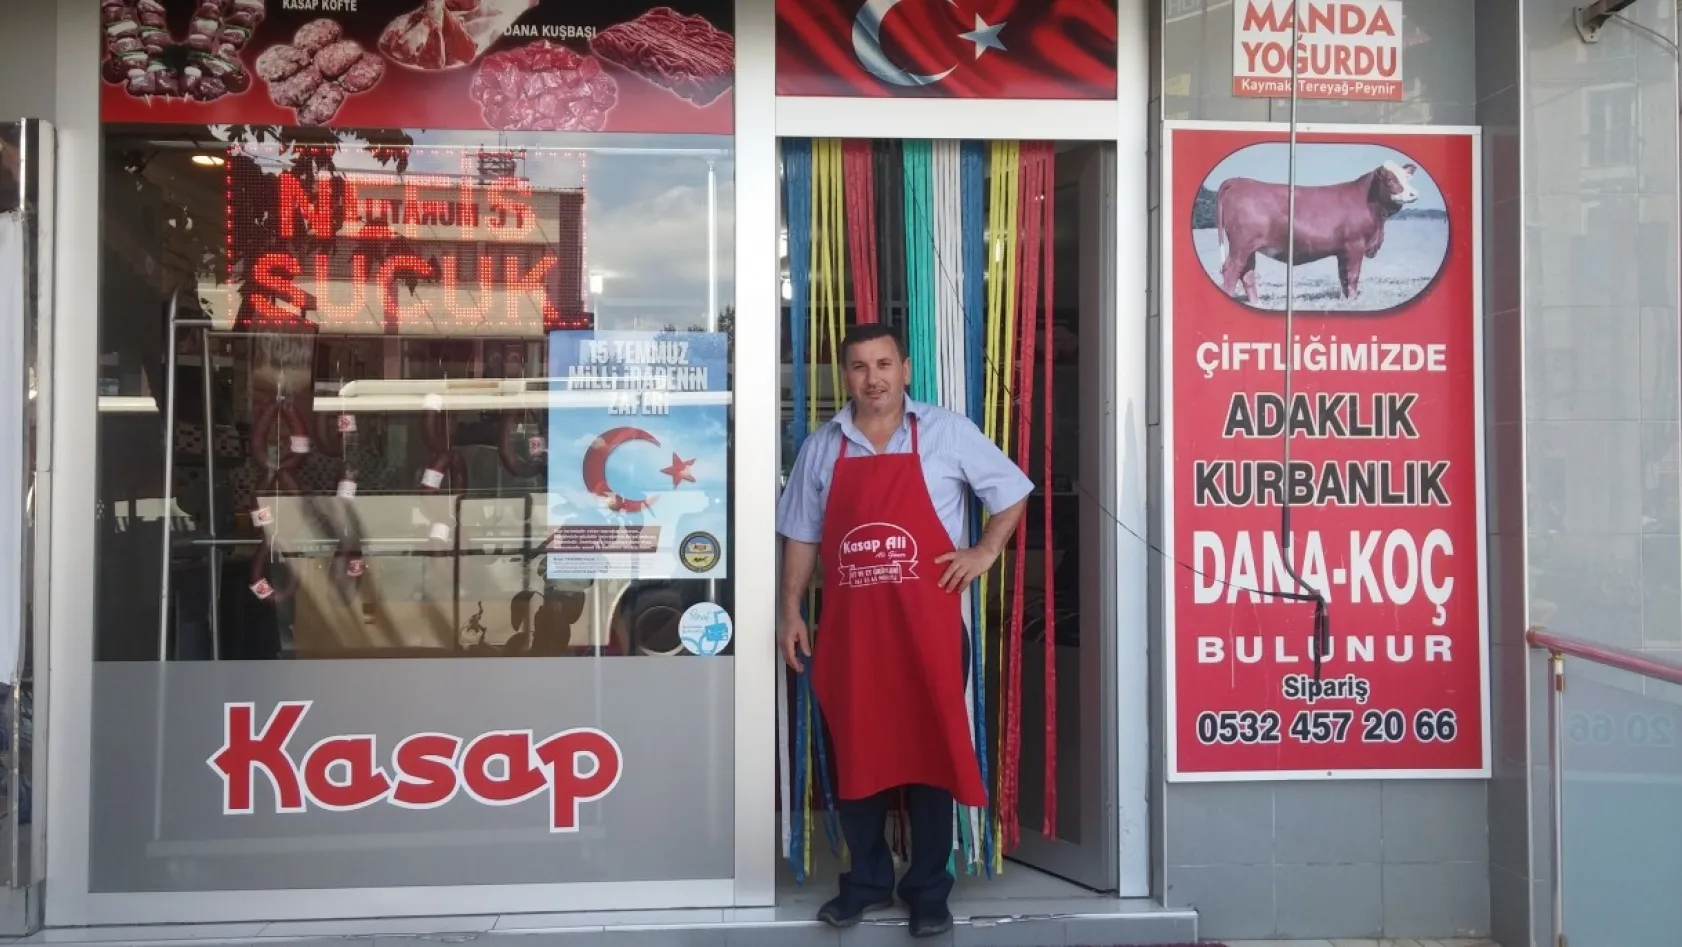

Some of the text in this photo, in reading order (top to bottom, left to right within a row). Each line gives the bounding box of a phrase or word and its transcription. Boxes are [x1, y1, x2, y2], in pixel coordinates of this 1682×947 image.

[283, 0, 318, 10] KASAP
[1243, 0, 1395, 36] MANDA
[503, 25, 597, 40] DANA KUŞBAŞI
[1241, 34, 1397, 77] YOĞURDU
[251, 253, 559, 319] SUCUK
[588, 340, 689, 364] 15 TEMMUZ
[1196, 335, 1447, 378] ÇİFTLİĞİMİZDE
[1222, 392, 1419, 438] ADAKLIK
[1194, 460, 1451, 507] KURBANLIK
[843, 536, 906, 554] Kasap Ali
[1193, 529, 1455, 626] DANA-KOÇ
[1197, 635, 1453, 663] BULUNUR
[1283, 673, 1369, 704] Sipariş
[1196, 710, 1457, 743] 0532 457 20 66
[206, 700, 623, 832] Kasap
